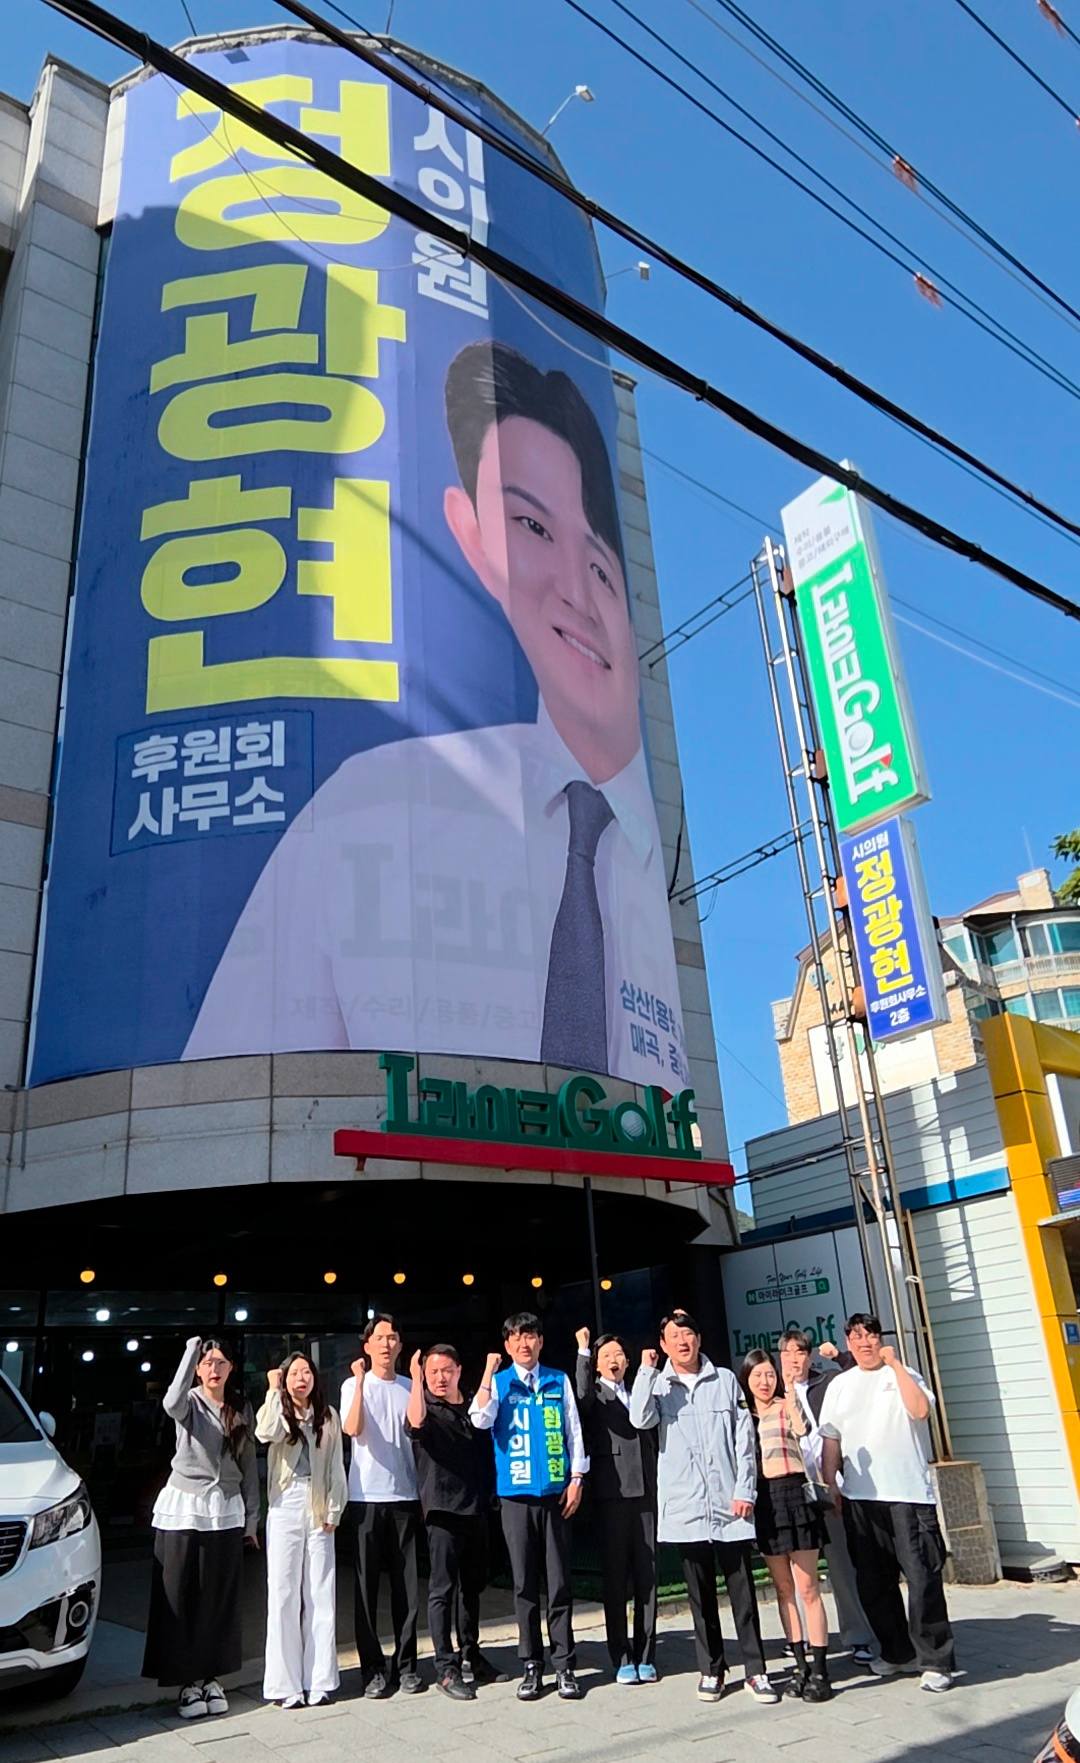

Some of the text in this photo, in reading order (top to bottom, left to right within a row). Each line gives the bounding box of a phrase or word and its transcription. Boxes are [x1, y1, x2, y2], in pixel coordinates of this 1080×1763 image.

[412, 103, 490, 320] 시의원
[140, 73, 407, 715] 정광현
[131, 720, 285, 784] 후원회
[127, 776, 286, 841] 사무소
[852, 831, 890, 861] 시의원
[855, 848, 914, 994] 정광현
[889, 1007, 912, 1027] 2층
[509, 1408, 532, 1485] 시의원
[544, 1406, 565, 1482] 정광현
